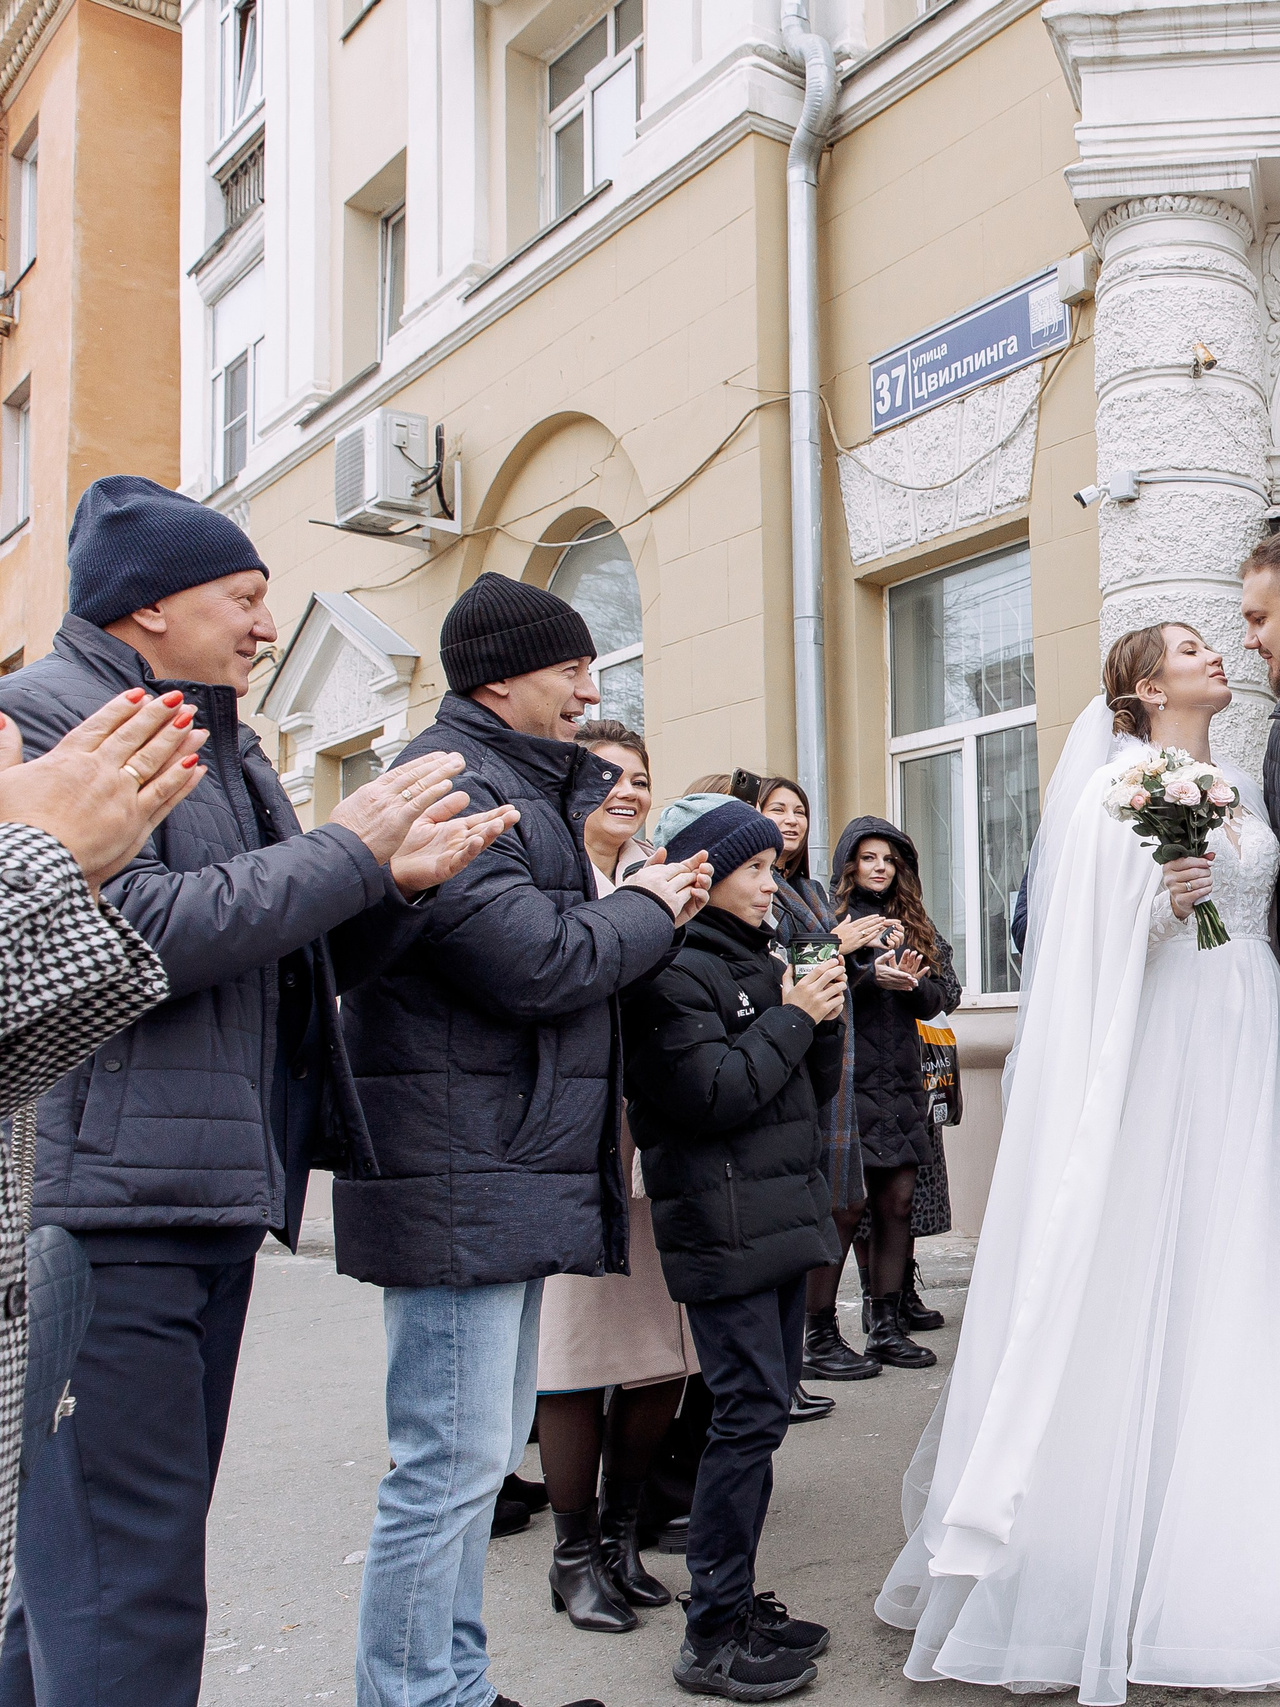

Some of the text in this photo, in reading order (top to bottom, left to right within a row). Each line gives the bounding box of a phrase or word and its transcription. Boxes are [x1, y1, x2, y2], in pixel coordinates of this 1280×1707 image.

[912, 342, 948, 373] улица
[914, 334, 1018, 400] Цвиллинга
[875, 364, 906, 415] 37
